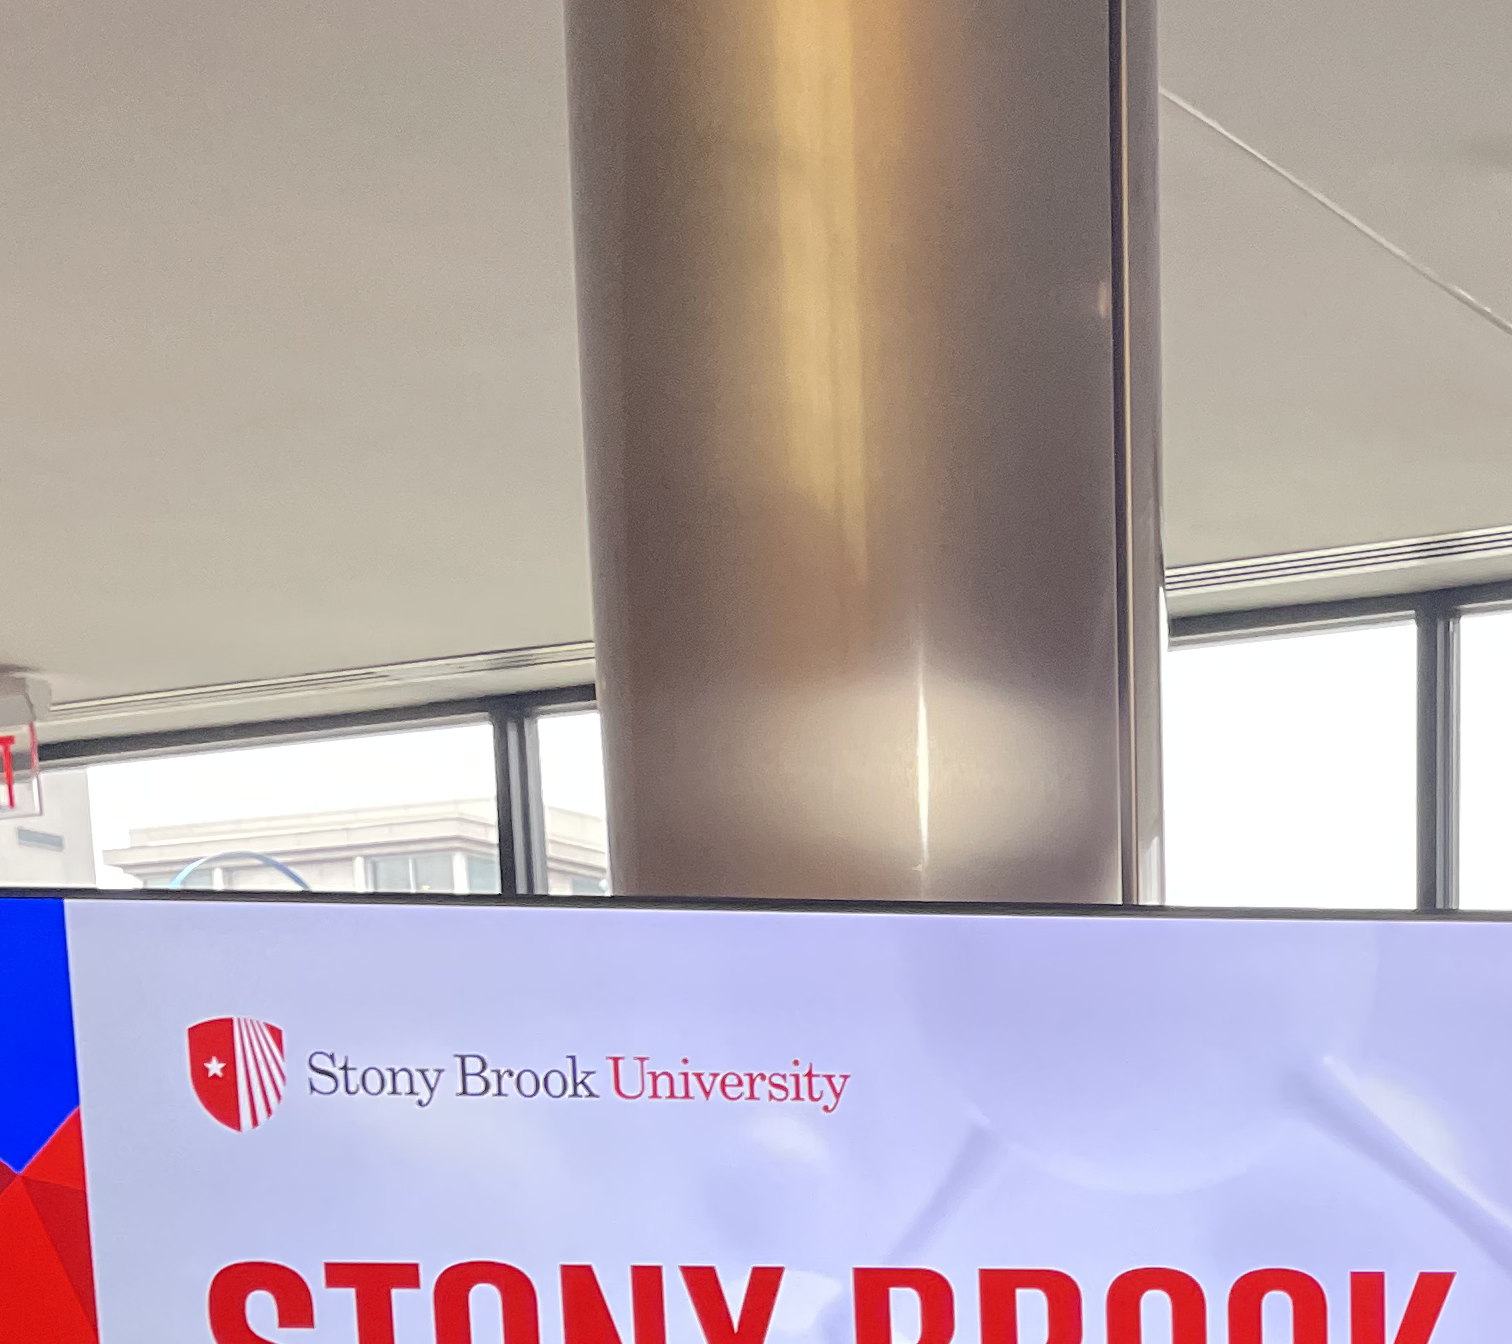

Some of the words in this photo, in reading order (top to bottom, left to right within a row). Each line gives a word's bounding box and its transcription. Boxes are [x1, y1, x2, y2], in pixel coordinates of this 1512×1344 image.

[307, 1051, 445, 1108] Stony
[453, 1053, 600, 1099] Brook
[605, 1056, 851, 1114] University
